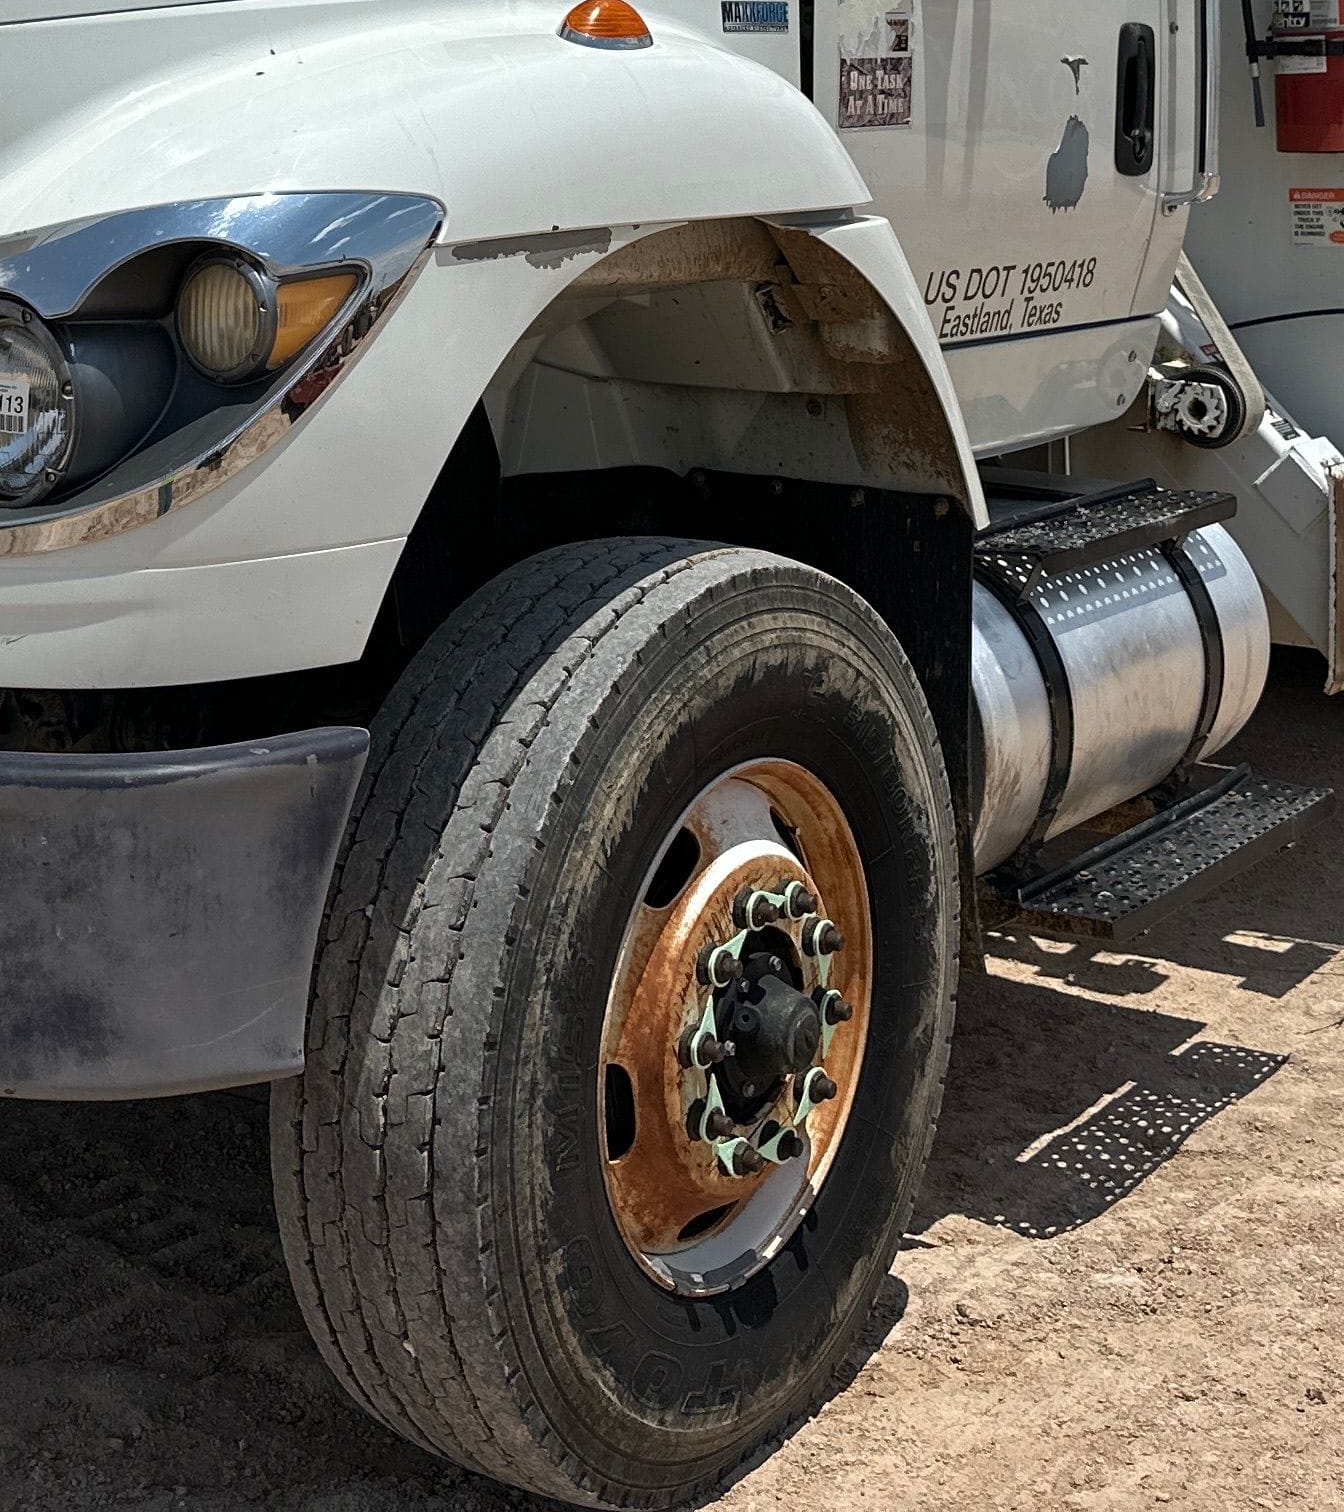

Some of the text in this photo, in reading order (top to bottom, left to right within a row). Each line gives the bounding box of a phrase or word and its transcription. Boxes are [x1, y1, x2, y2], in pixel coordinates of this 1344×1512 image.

[924, 257, 1097, 305] US DOT 1950418
[939, 296, 1063, 339] Eastland, Texas
